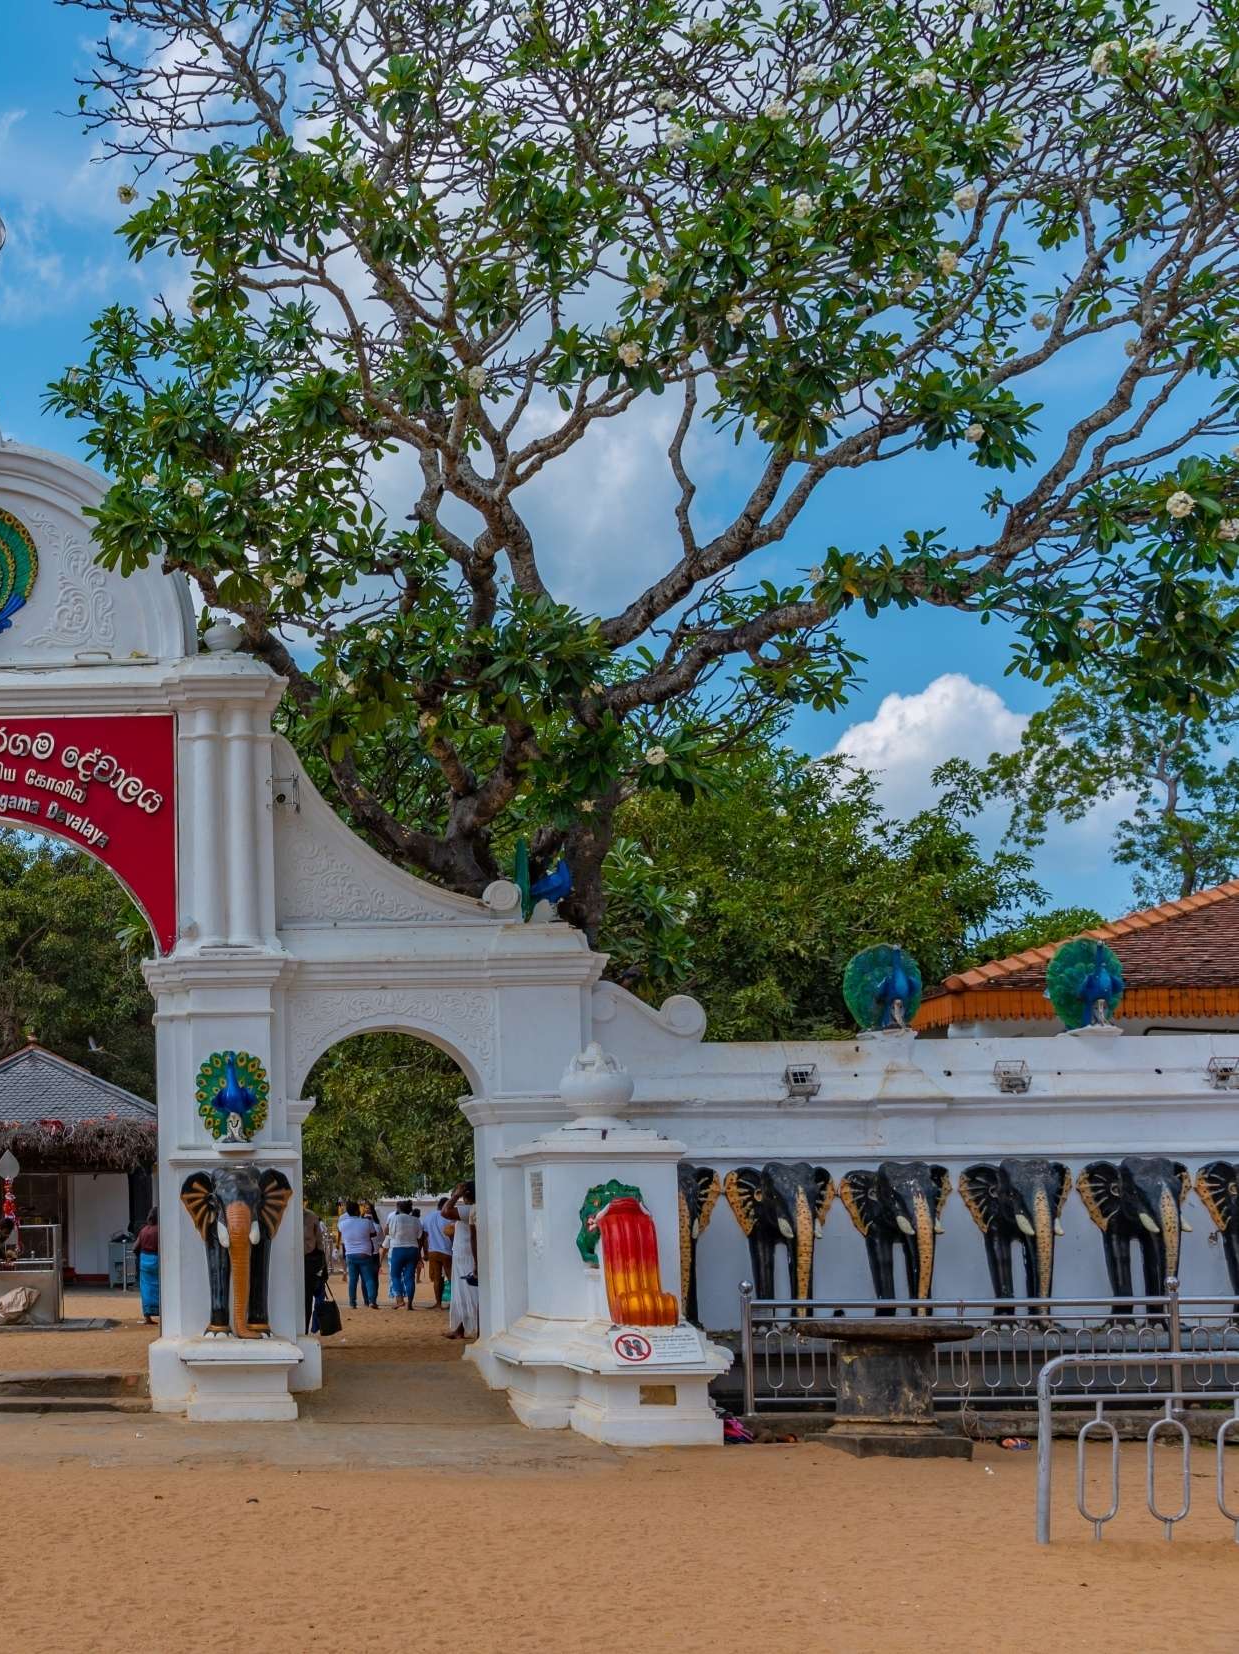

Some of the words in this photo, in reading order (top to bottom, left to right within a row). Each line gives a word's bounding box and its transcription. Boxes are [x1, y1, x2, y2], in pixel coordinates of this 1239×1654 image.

[24, 768, 87, 804] கோவில்
[61, 746, 163, 814] දේවාලය
[45, 800, 110, 849] Devalaya
